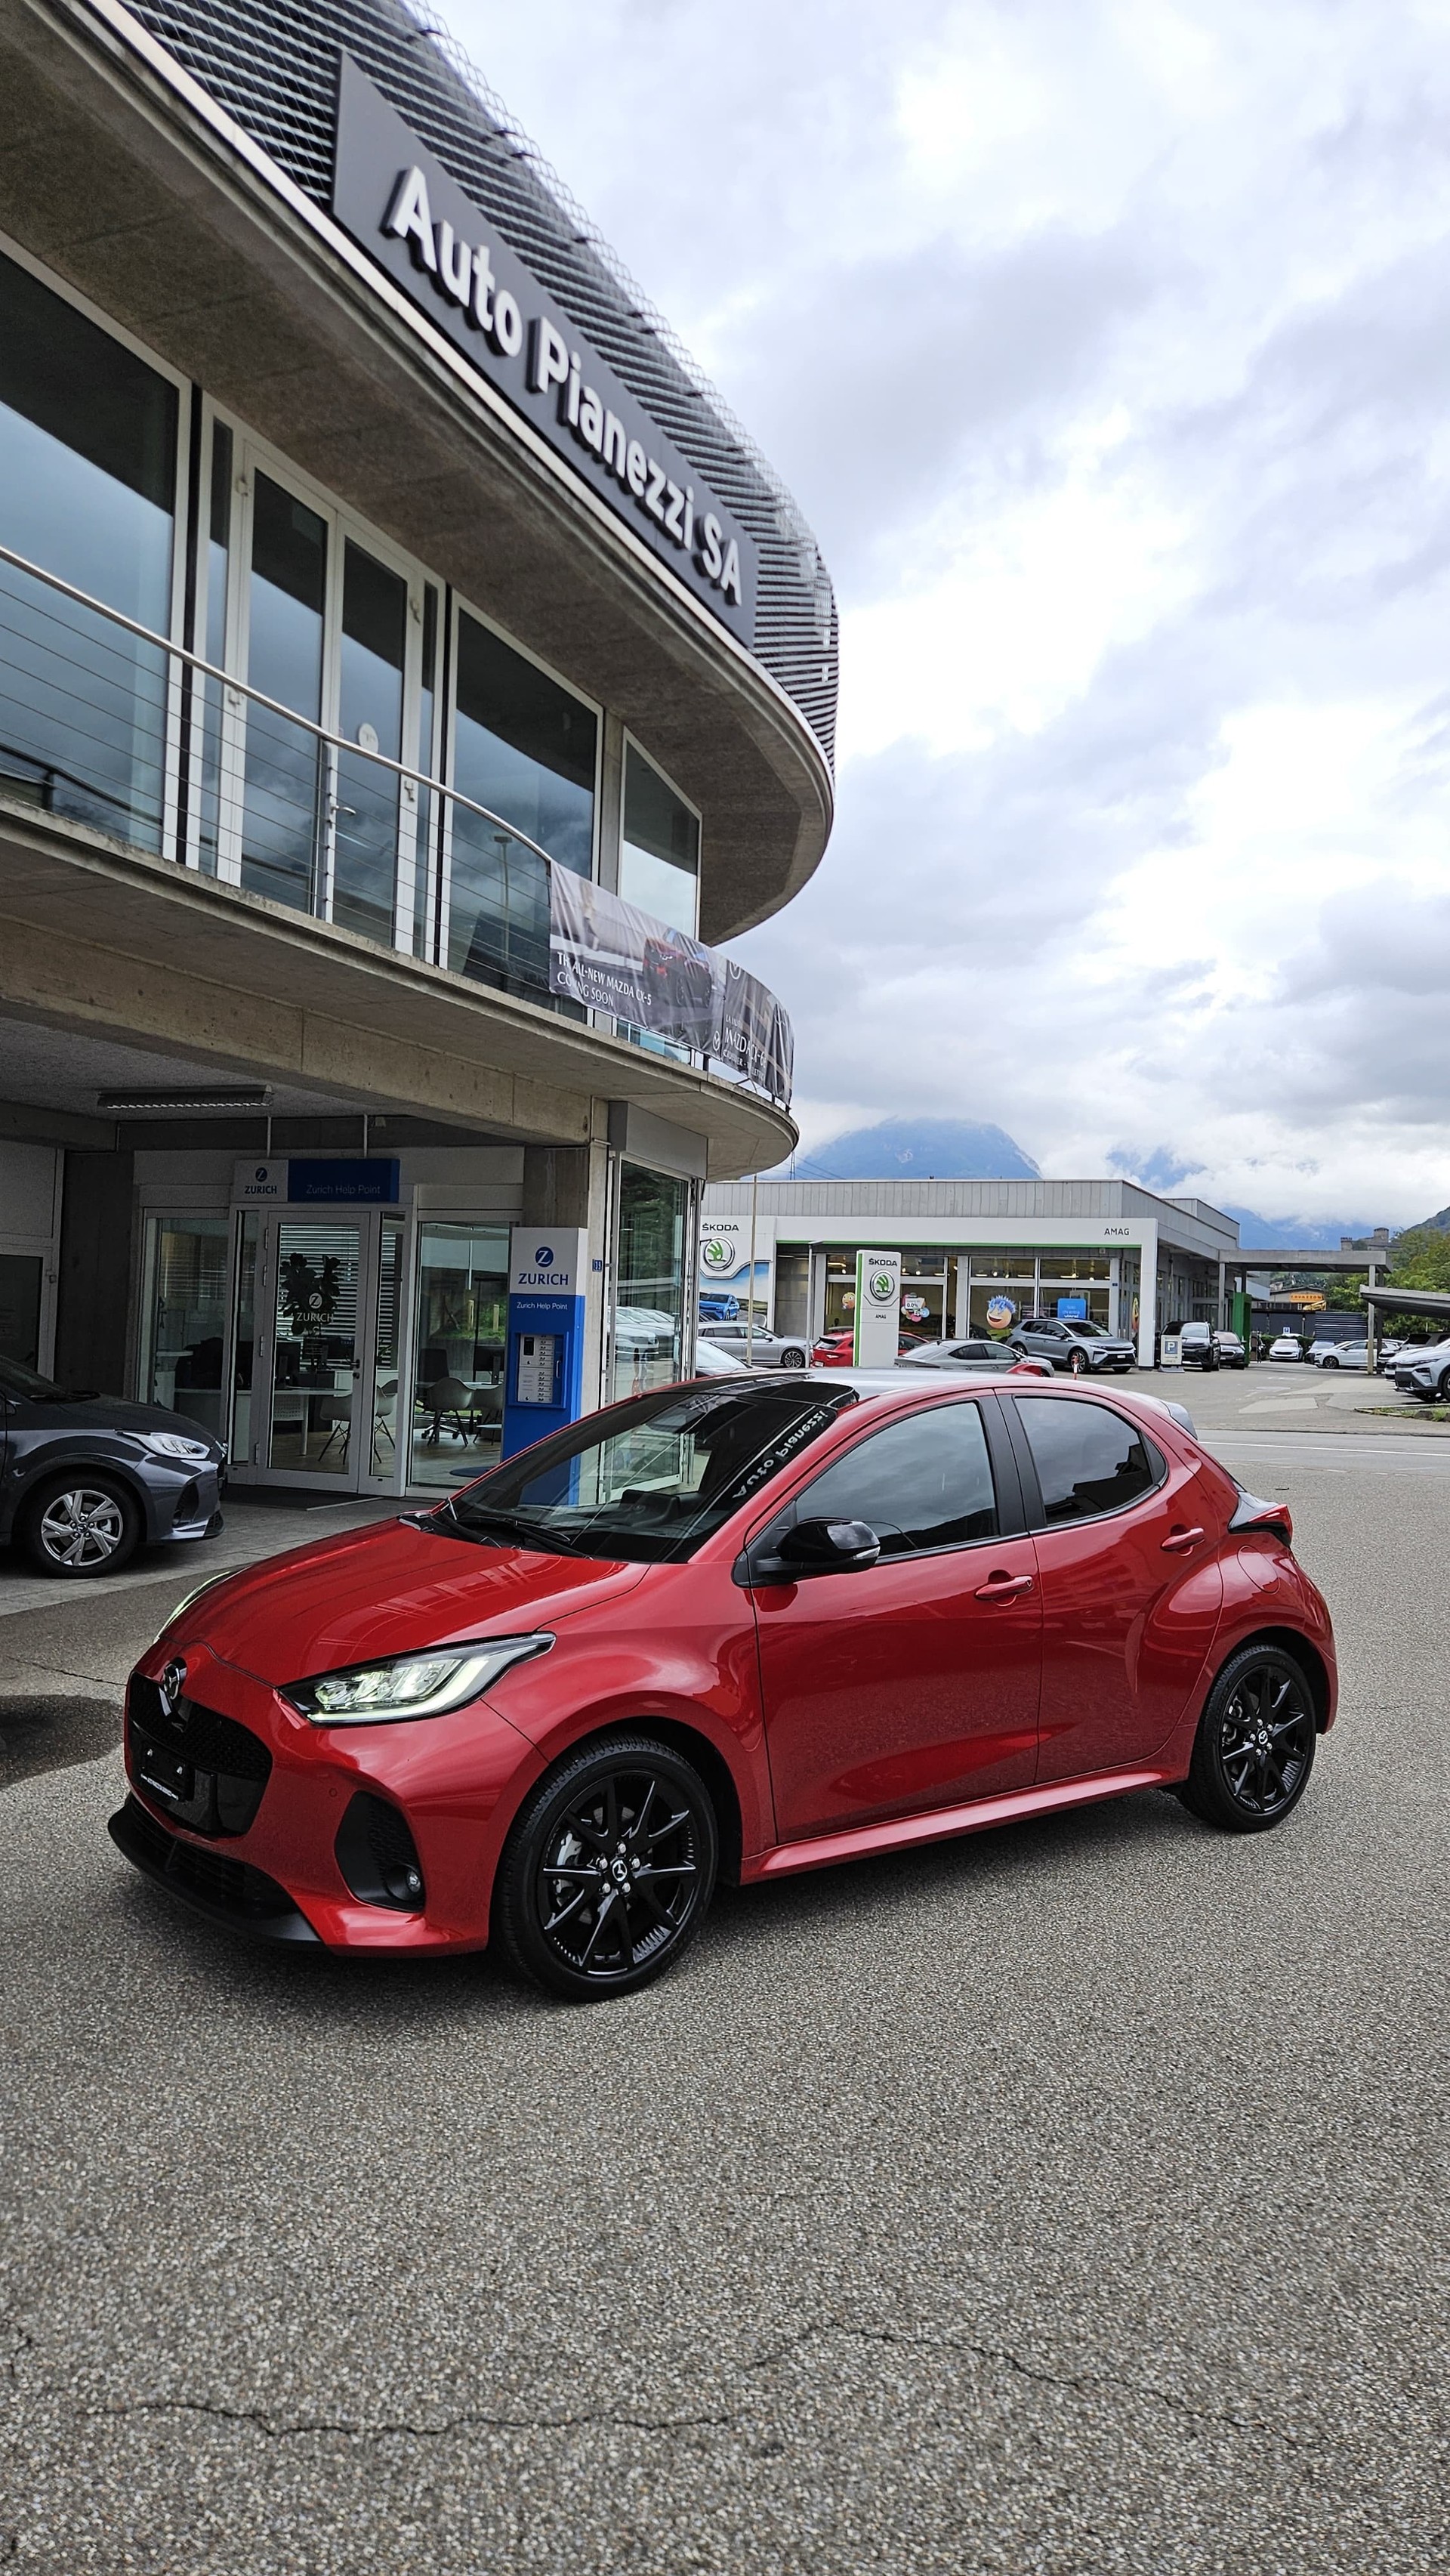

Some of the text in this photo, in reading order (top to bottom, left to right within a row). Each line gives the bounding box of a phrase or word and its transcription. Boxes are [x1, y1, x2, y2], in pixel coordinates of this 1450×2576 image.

[384, 165, 742, 607] Auto Pianezzi SA
[572, 962, 606, 985] ALL-NEW
[606, 975, 634, 998] MAZDA
[636, 988, 652, 1005] CX-5
[591, 986, 614, 1007] SOON
[244, 1185, 277, 1194] ZURICH
[306, 1185, 381, 1196] Zurich Help Point
[702, 1222, 739, 1231] ŠKODA
[1103, 1228, 1130, 1236] AMAG
[868, 1258, 898, 1267] ŠKODA
[518, 1273, 569, 1285] ZURICH
[517, 1301, 535, 1309] Zurich
[536, 1302, 551, 1311] Help
[296, 1312, 334, 1323] ZURICH
[1168, 1342, 1175, 1351] P
